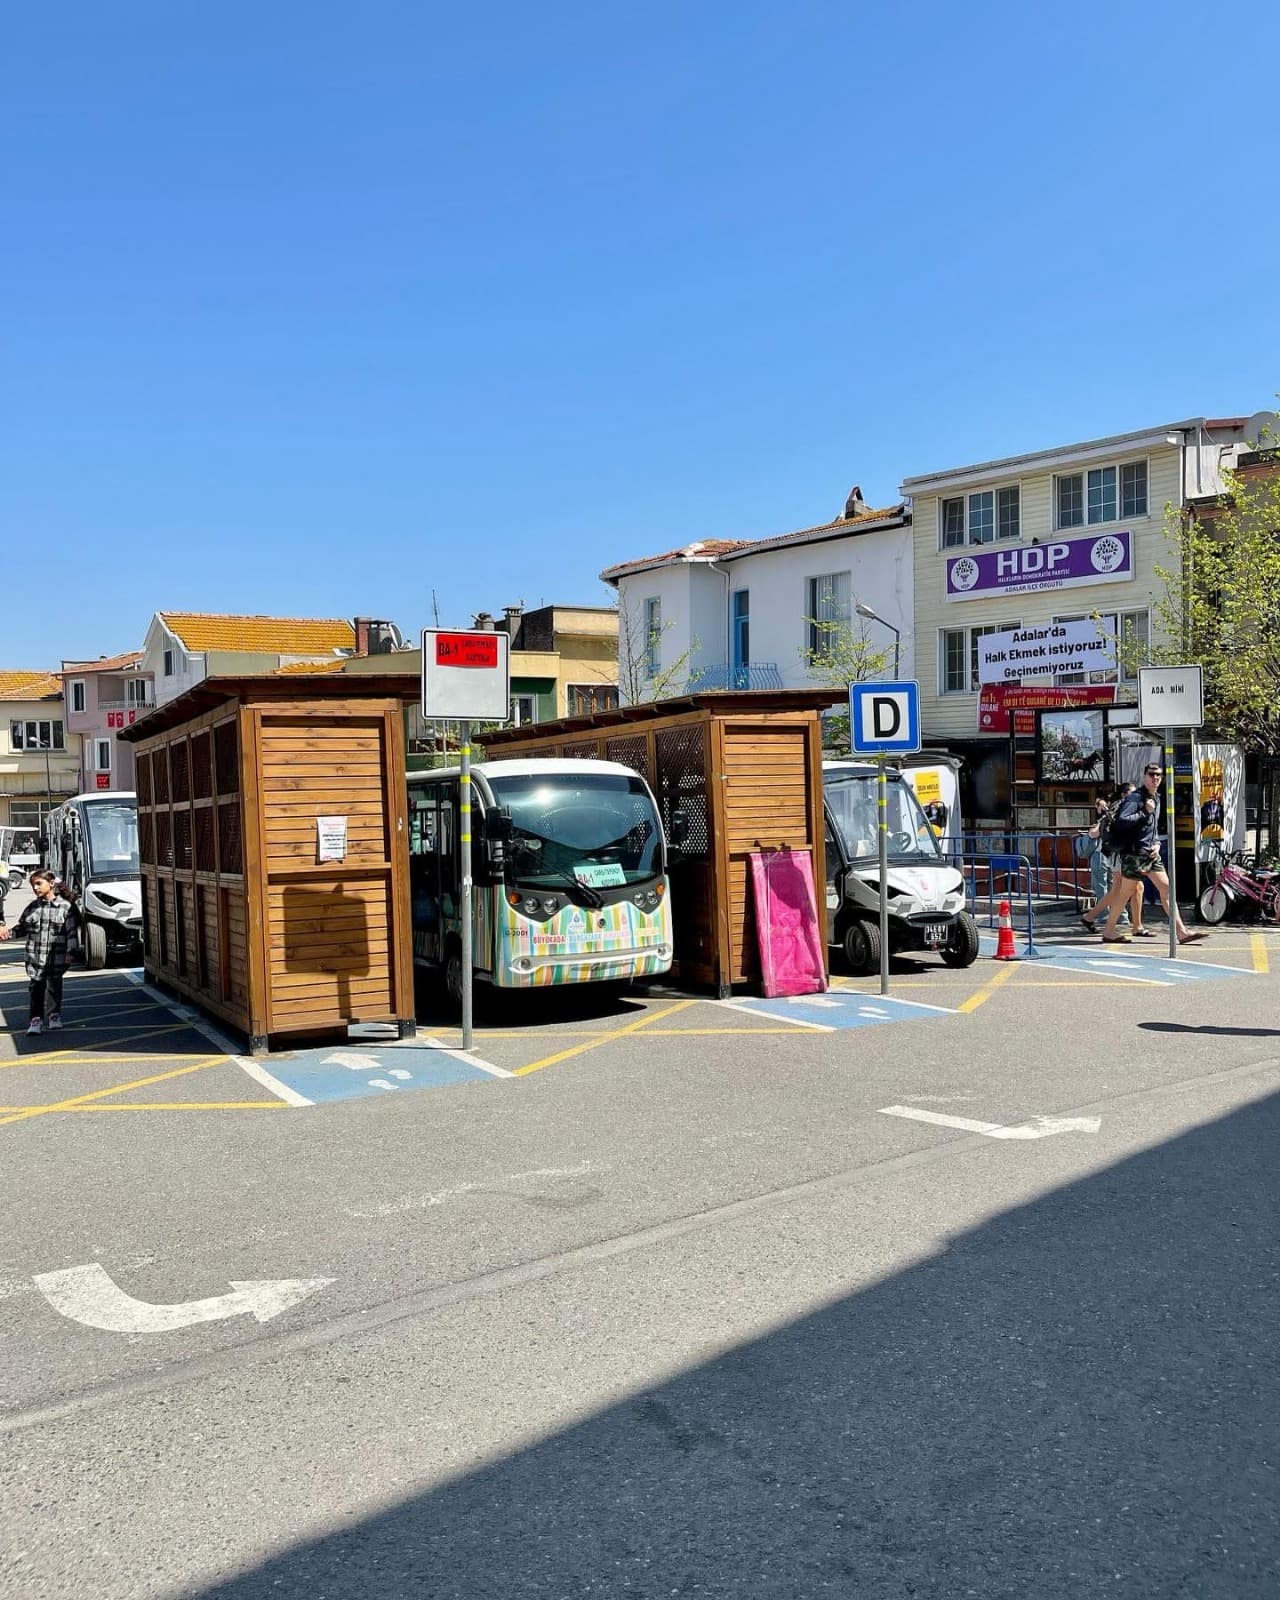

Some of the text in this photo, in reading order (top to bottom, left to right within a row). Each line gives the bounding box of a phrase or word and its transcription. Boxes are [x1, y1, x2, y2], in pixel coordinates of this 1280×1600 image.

[997, 544, 1070, 576] HDP
[997, 575, 1022, 583] HALKLARIN
[1005, 585, 1026, 593] ADALAR
[1039, 580, 1063, 590] ÖRGÜTÜ
[1012, 627, 1067, 643] Adalar'da
[985, 637, 1107, 664] Halk Ekmek istiyoruz!
[1004, 660, 1084, 678] Geçinemiyoruz
[1151, 685, 1164, 695] ADA
[872, 697, 901, 738] D
